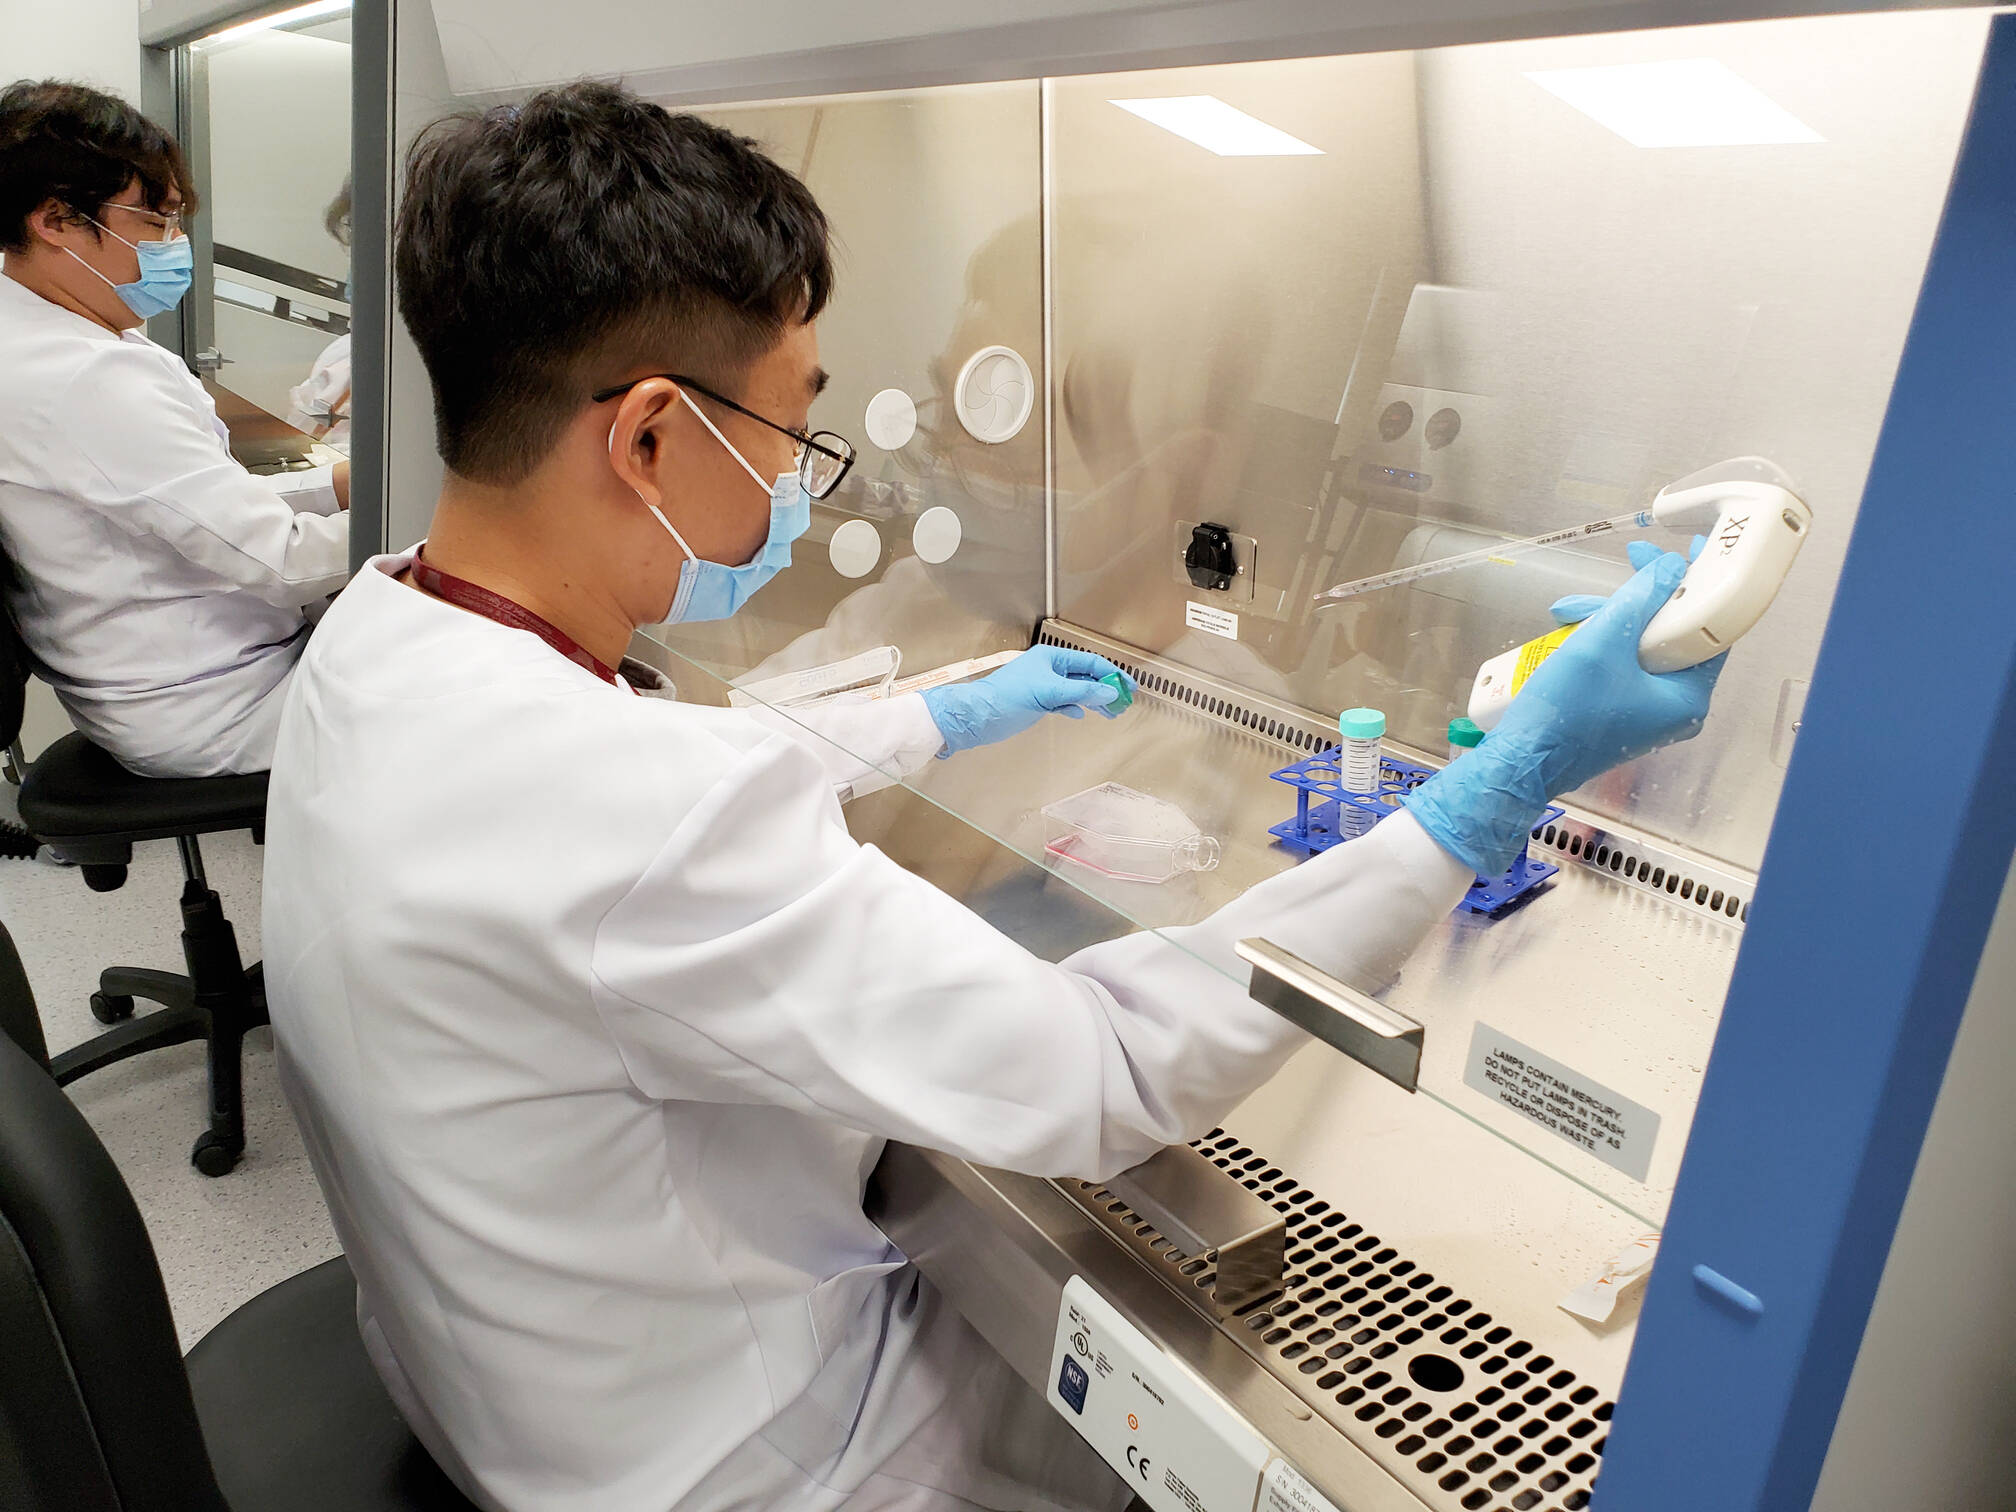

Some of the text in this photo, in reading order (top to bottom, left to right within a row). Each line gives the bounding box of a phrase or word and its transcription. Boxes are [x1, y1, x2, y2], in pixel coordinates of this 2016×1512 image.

[1484, 1056, 1499, 1069] DO
[1500, 1064, 1519, 1080] NOT
[1521, 1075, 1541, 1092] PUT
[1542, 1087, 1574, 1112] LAMPS
[1577, 1106, 1588, 1117] IN
[1484, 1069, 1621, 1149] RECYCLE OR DISPOSE OF AS
[1493, 1048, 1622, 1123] LAMPS CONTAIN MERCURY.
[1499, 1091, 1558, 1129] HAZARDOUS
[1066, 1365, 1082, 1387] NSF
